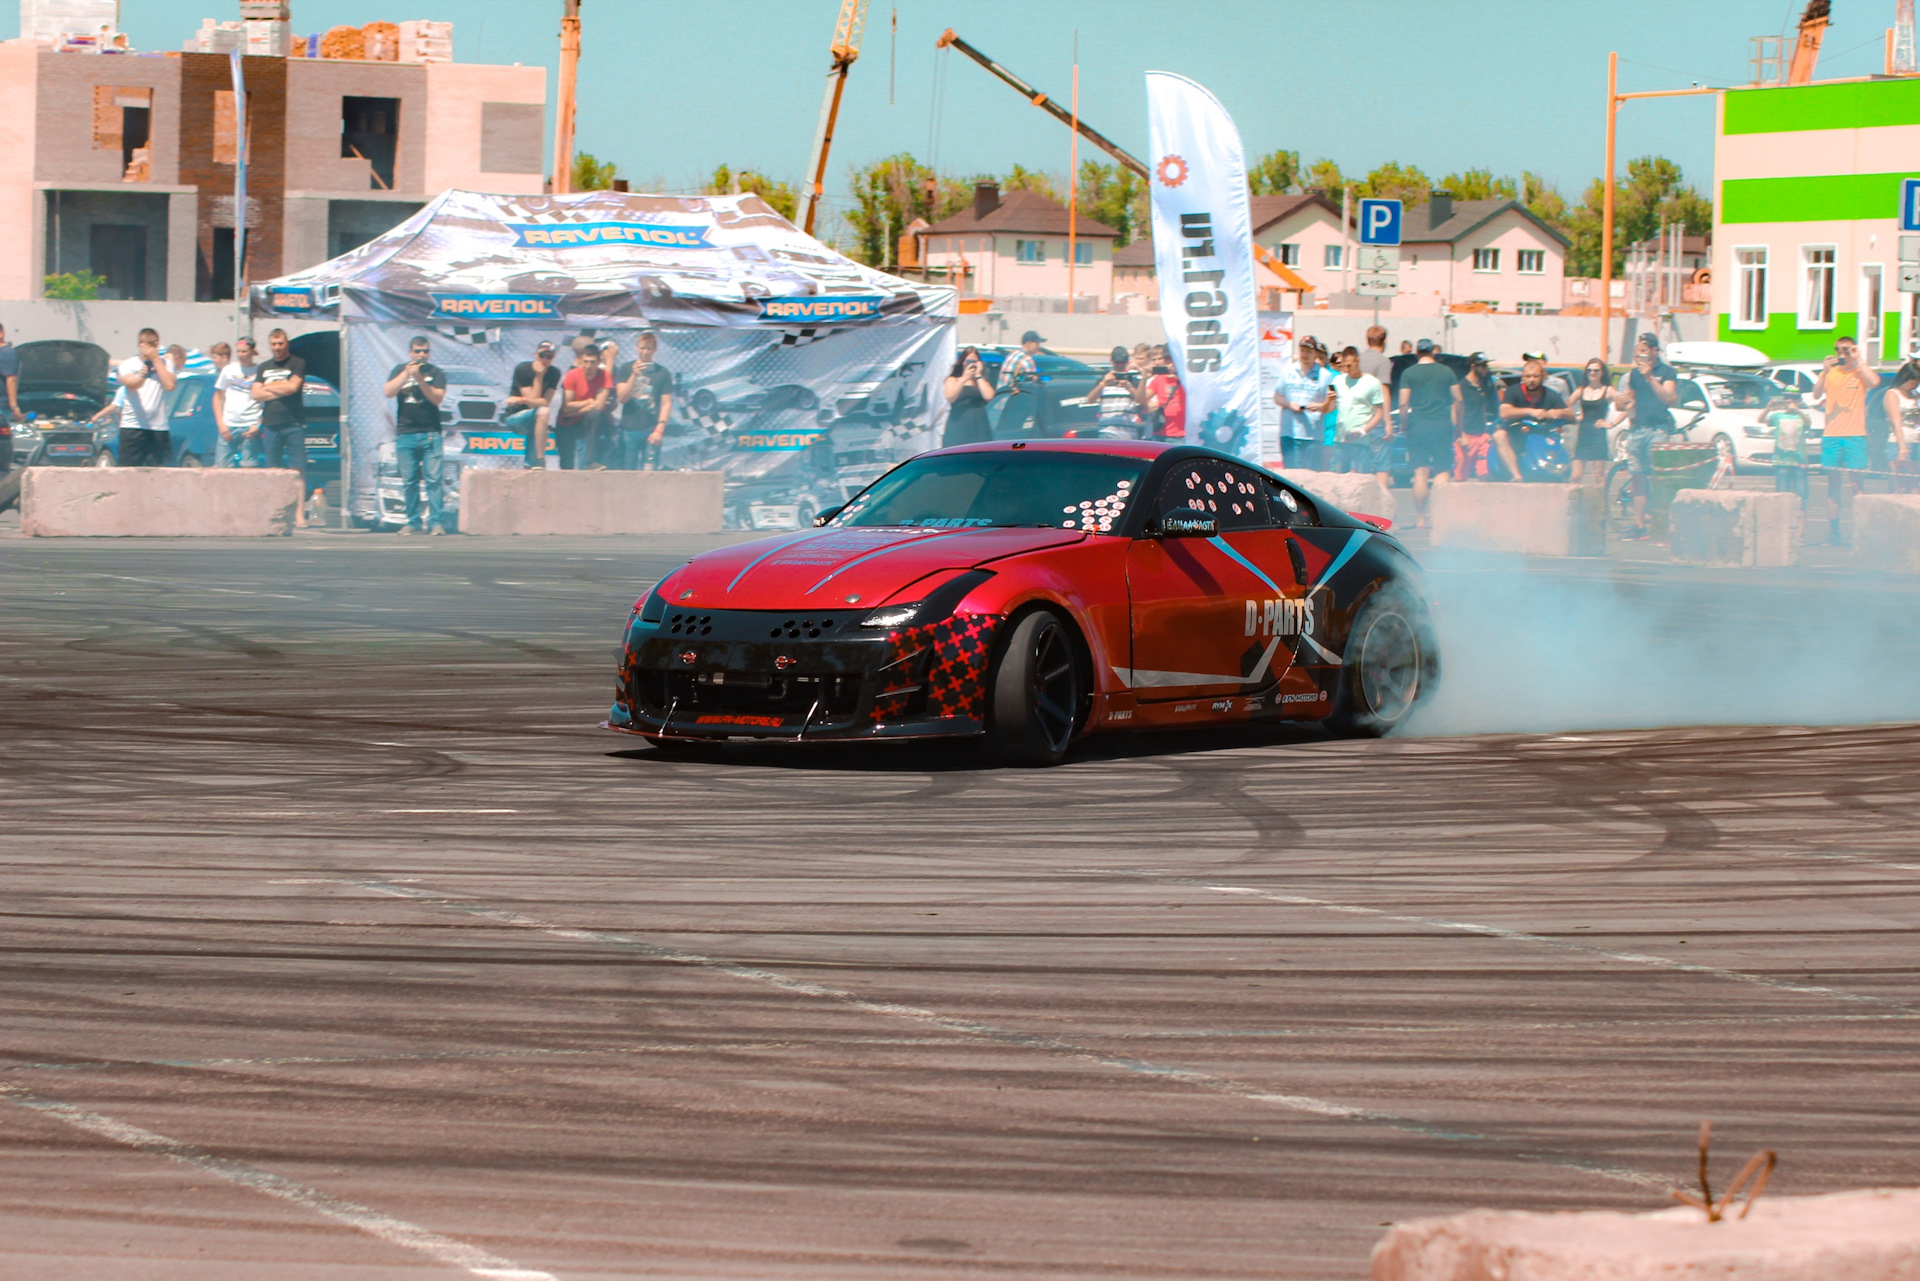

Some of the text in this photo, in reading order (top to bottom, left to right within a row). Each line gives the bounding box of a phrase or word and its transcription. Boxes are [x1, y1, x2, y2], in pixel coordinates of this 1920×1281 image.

[1369, 205, 1392, 239] P
[523, 226, 700, 245] RAVENOL
[441, 299, 552, 314] RAVENOL
[766, 302, 875, 316] RAVENOL
